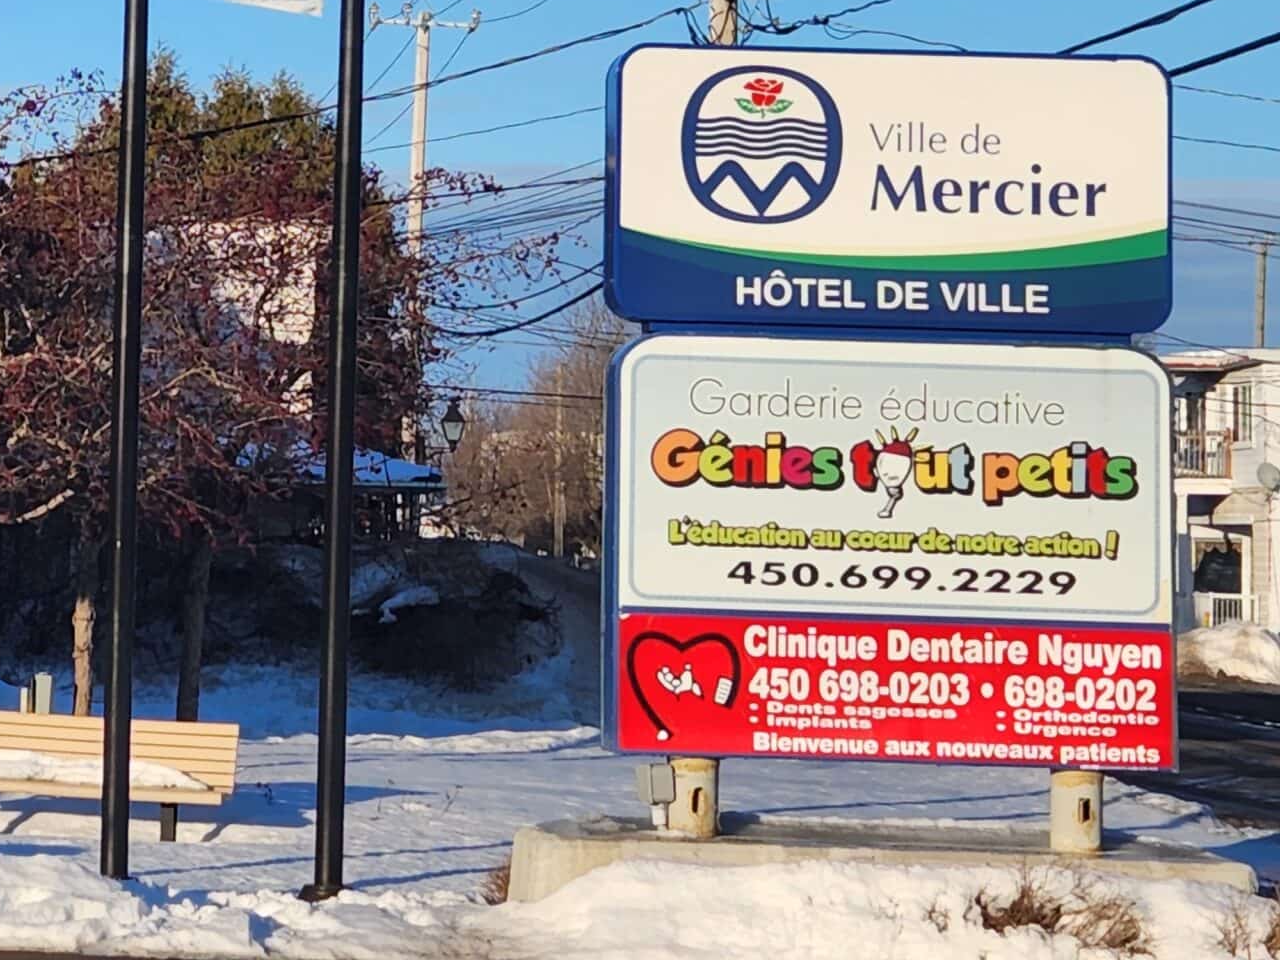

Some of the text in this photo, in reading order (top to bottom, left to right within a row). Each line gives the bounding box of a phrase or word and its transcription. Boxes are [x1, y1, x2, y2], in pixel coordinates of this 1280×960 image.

[869, 121, 1002, 155] Ville de
[869, 163, 1107, 218] Mercier
[735, 270, 1050, 314] HÔTEL DE VILLE
[688, 377, 1066, 426] Garderie éducative
[650, 427, 845, 492] Génies
[981, 441, 1138, 507] petits
[668, 515, 809, 548] L'éducation
[810, 528, 844, 550] au
[846, 530, 916, 553] coeur
[918, 527, 953, 554] de
[953, 530, 1022, 557] notre
[1022, 530, 1102, 559] action
[727, 560, 1078, 596] 450.699.2229
[743, 625, 1163, 675] Clinique Dentaire Nguyen
[749, 668, 1157, 711] 450 698-0203 698-0202
[766, 701, 958, 720] Dents sagesses
[766, 715, 872, 730] Implants
[1013, 708, 1160, 726] Orthodontie
[1013, 721, 1118, 738] Urgence
[752, 731, 1161, 765] Bienvenue aux nouveaux patients
